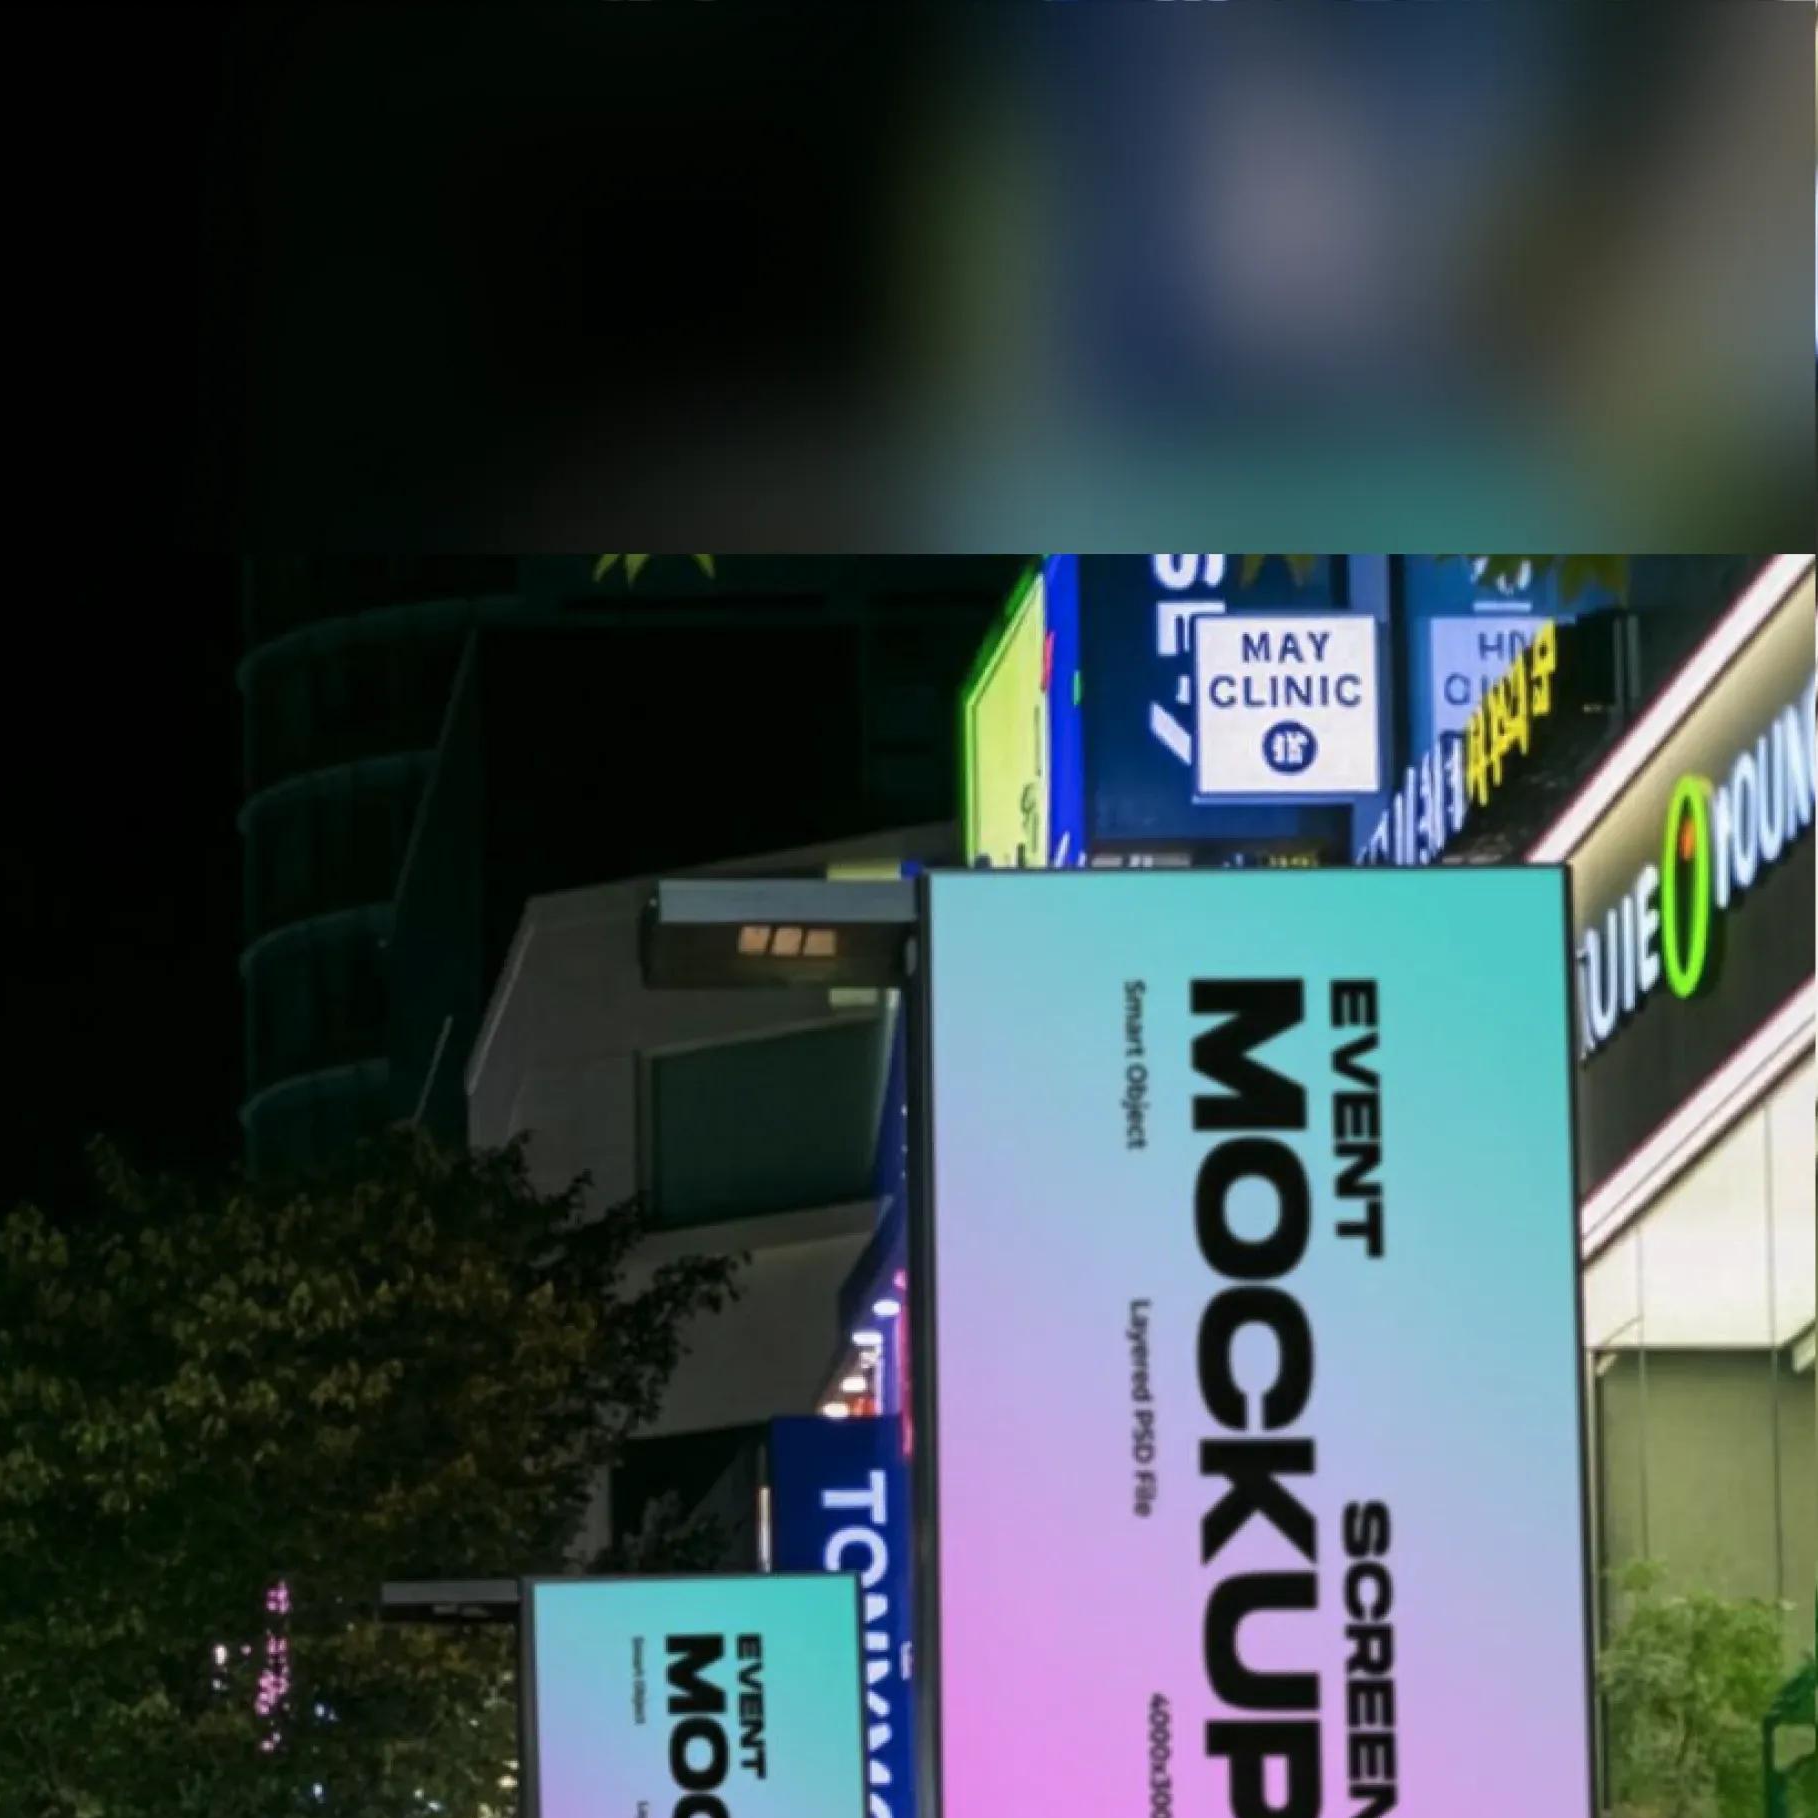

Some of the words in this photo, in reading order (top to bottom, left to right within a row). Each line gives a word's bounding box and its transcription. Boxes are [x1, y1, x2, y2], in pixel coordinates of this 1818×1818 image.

[1242, 632, 1331, 663] MAY
[1208, 674, 1363, 708] CLINIC
[1124, 979, 1146, 1057] Smart
[1122, 1063, 1148, 1149] Object
[1330, 979, 1384, 1257] EVENT
[1126, 1299, 1153, 1403] Layered
[1132, 1408, 1155, 1464] PSD
[1133, 1470, 1157, 1517] File
[736, 1633, 767, 1779] EVENT
